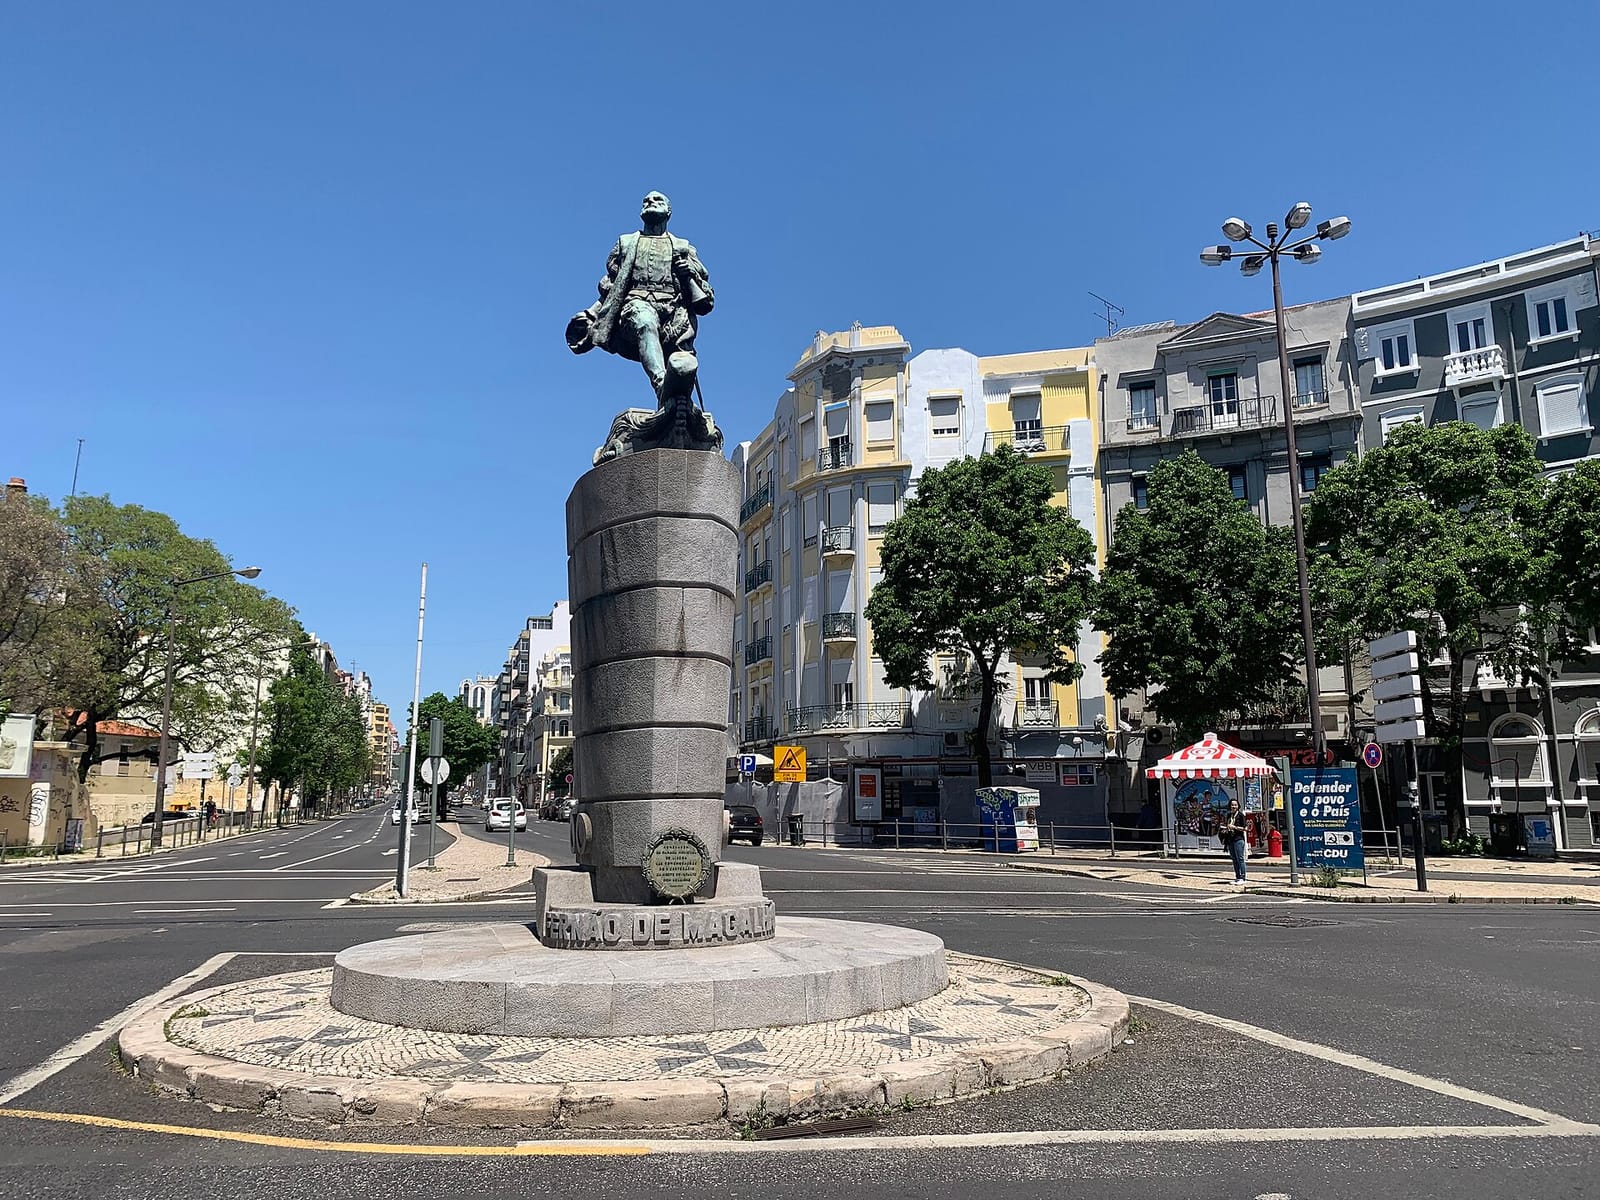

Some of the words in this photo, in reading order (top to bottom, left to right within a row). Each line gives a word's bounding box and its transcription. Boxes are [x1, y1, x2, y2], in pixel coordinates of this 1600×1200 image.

[743, 757, 753, 771] P
[1294, 780, 1352, 794] Defender
[1302, 795, 1311, 805] o
[1314, 795, 1345, 808] povo
[1299, 808, 1308, 817] e
[1311, 808, 1320, 817] o
[1323, 804, 1350, 817] País
[1323, 849, 1349, 858] CDU
[632, 912, 671, 945] DE
